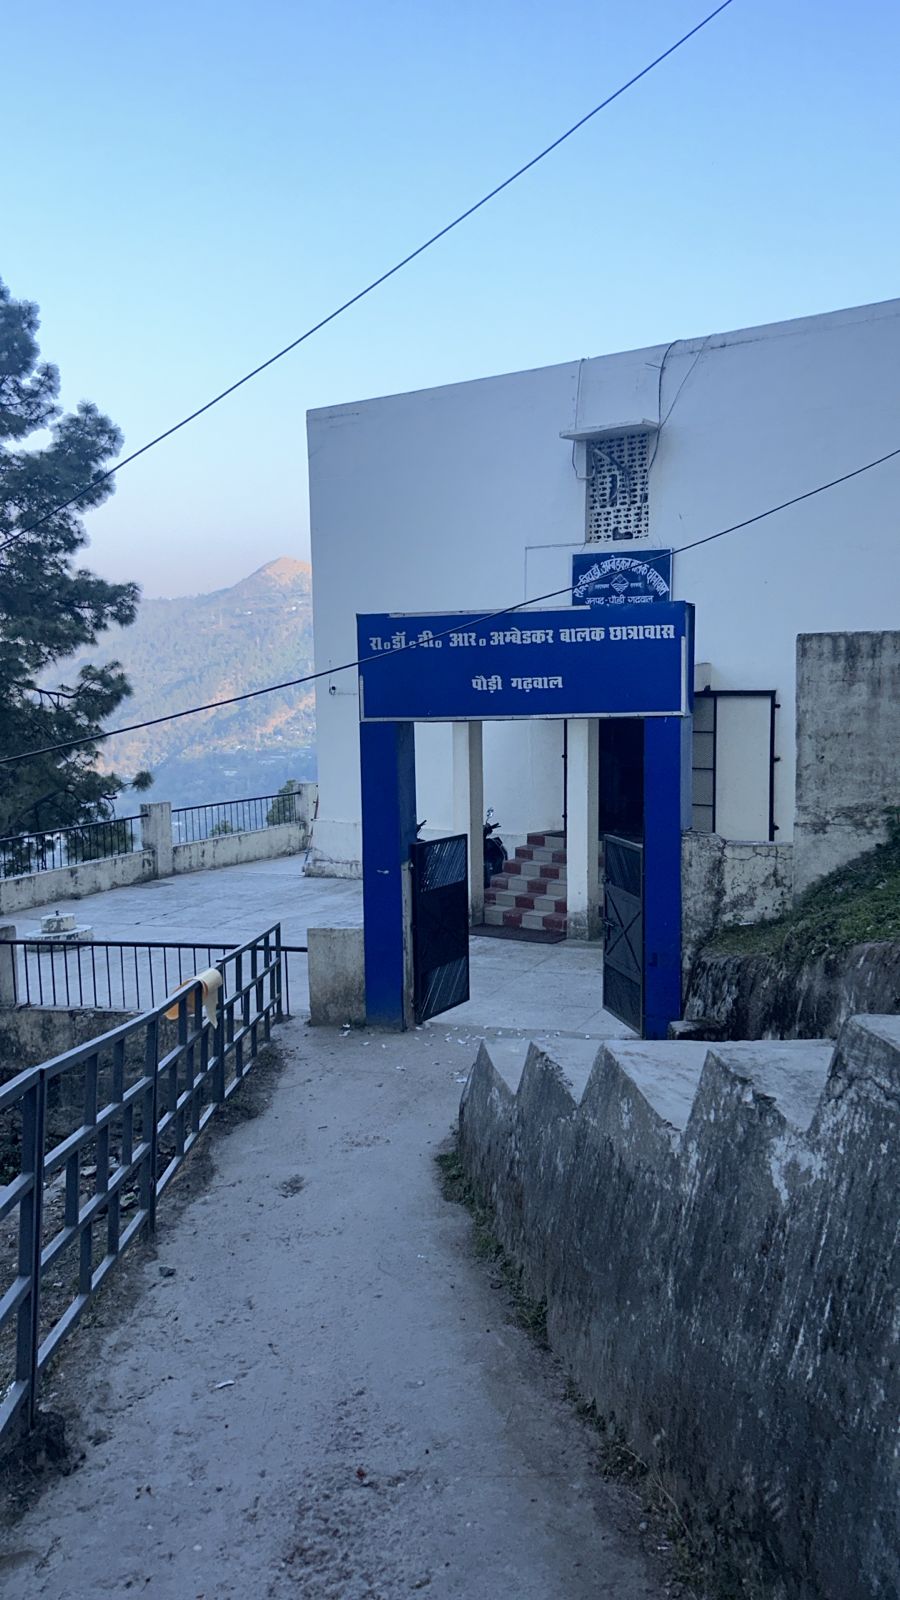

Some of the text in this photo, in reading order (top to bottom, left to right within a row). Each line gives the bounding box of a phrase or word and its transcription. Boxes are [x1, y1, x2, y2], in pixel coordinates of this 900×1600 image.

[490, 627, 554, 645] अम्बेडकर
[559, 627, 605, 643] बालक
[609, 624, 675, 641] छात्रावास
[471, 675, 563, 693] पौड़ी गढ़वाल
